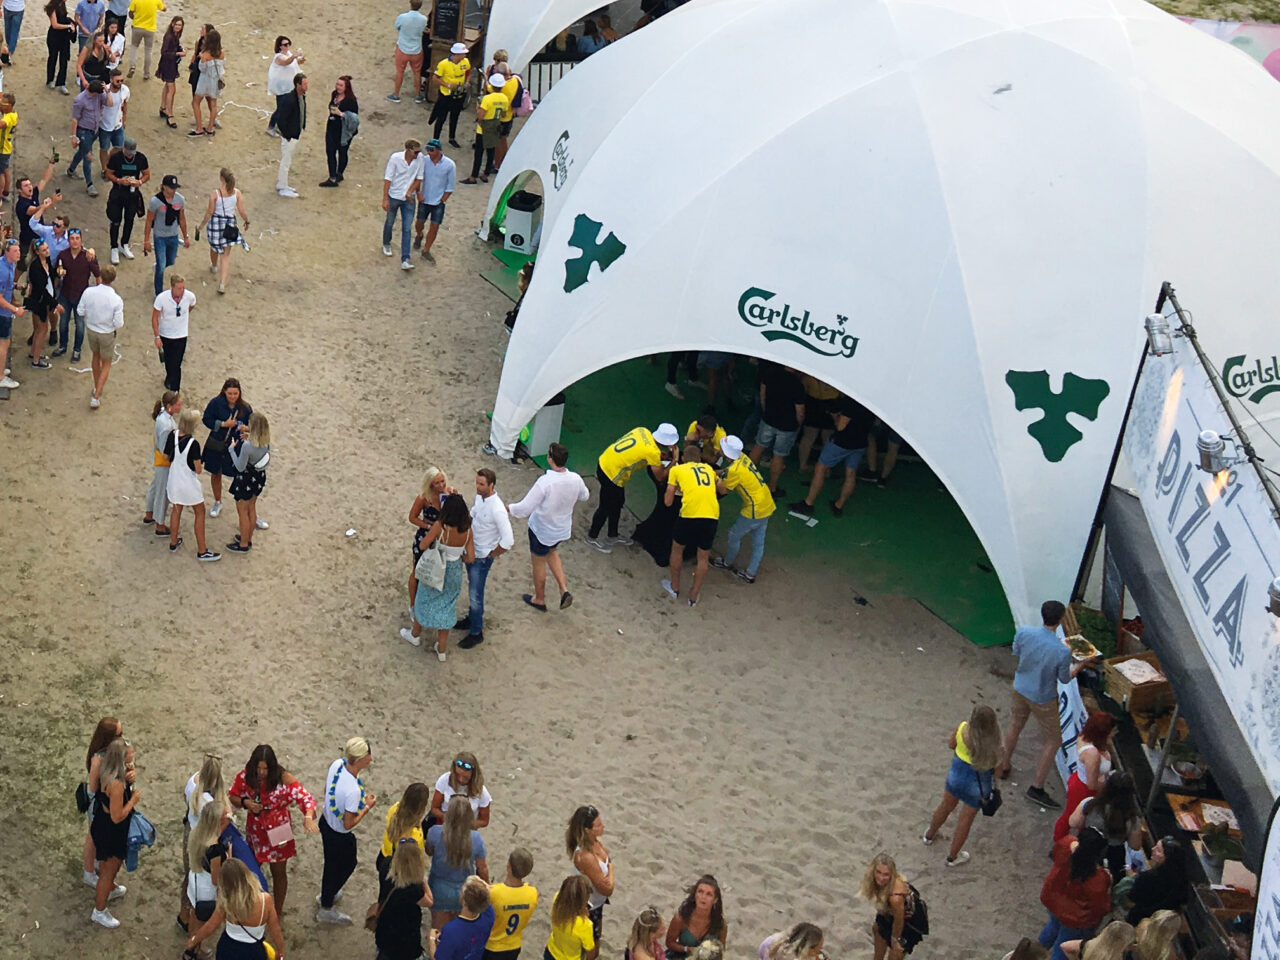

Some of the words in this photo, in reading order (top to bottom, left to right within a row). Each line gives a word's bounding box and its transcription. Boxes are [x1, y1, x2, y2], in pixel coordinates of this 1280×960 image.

[737, 286, 860, 359] Carlsberg
[1222, 354, 1280, 398] Carlsb
[691, 466, 711, 487] 15
[1155, 429, 1248, 669] PIZZA
[505, 913, 520, 936] 9
